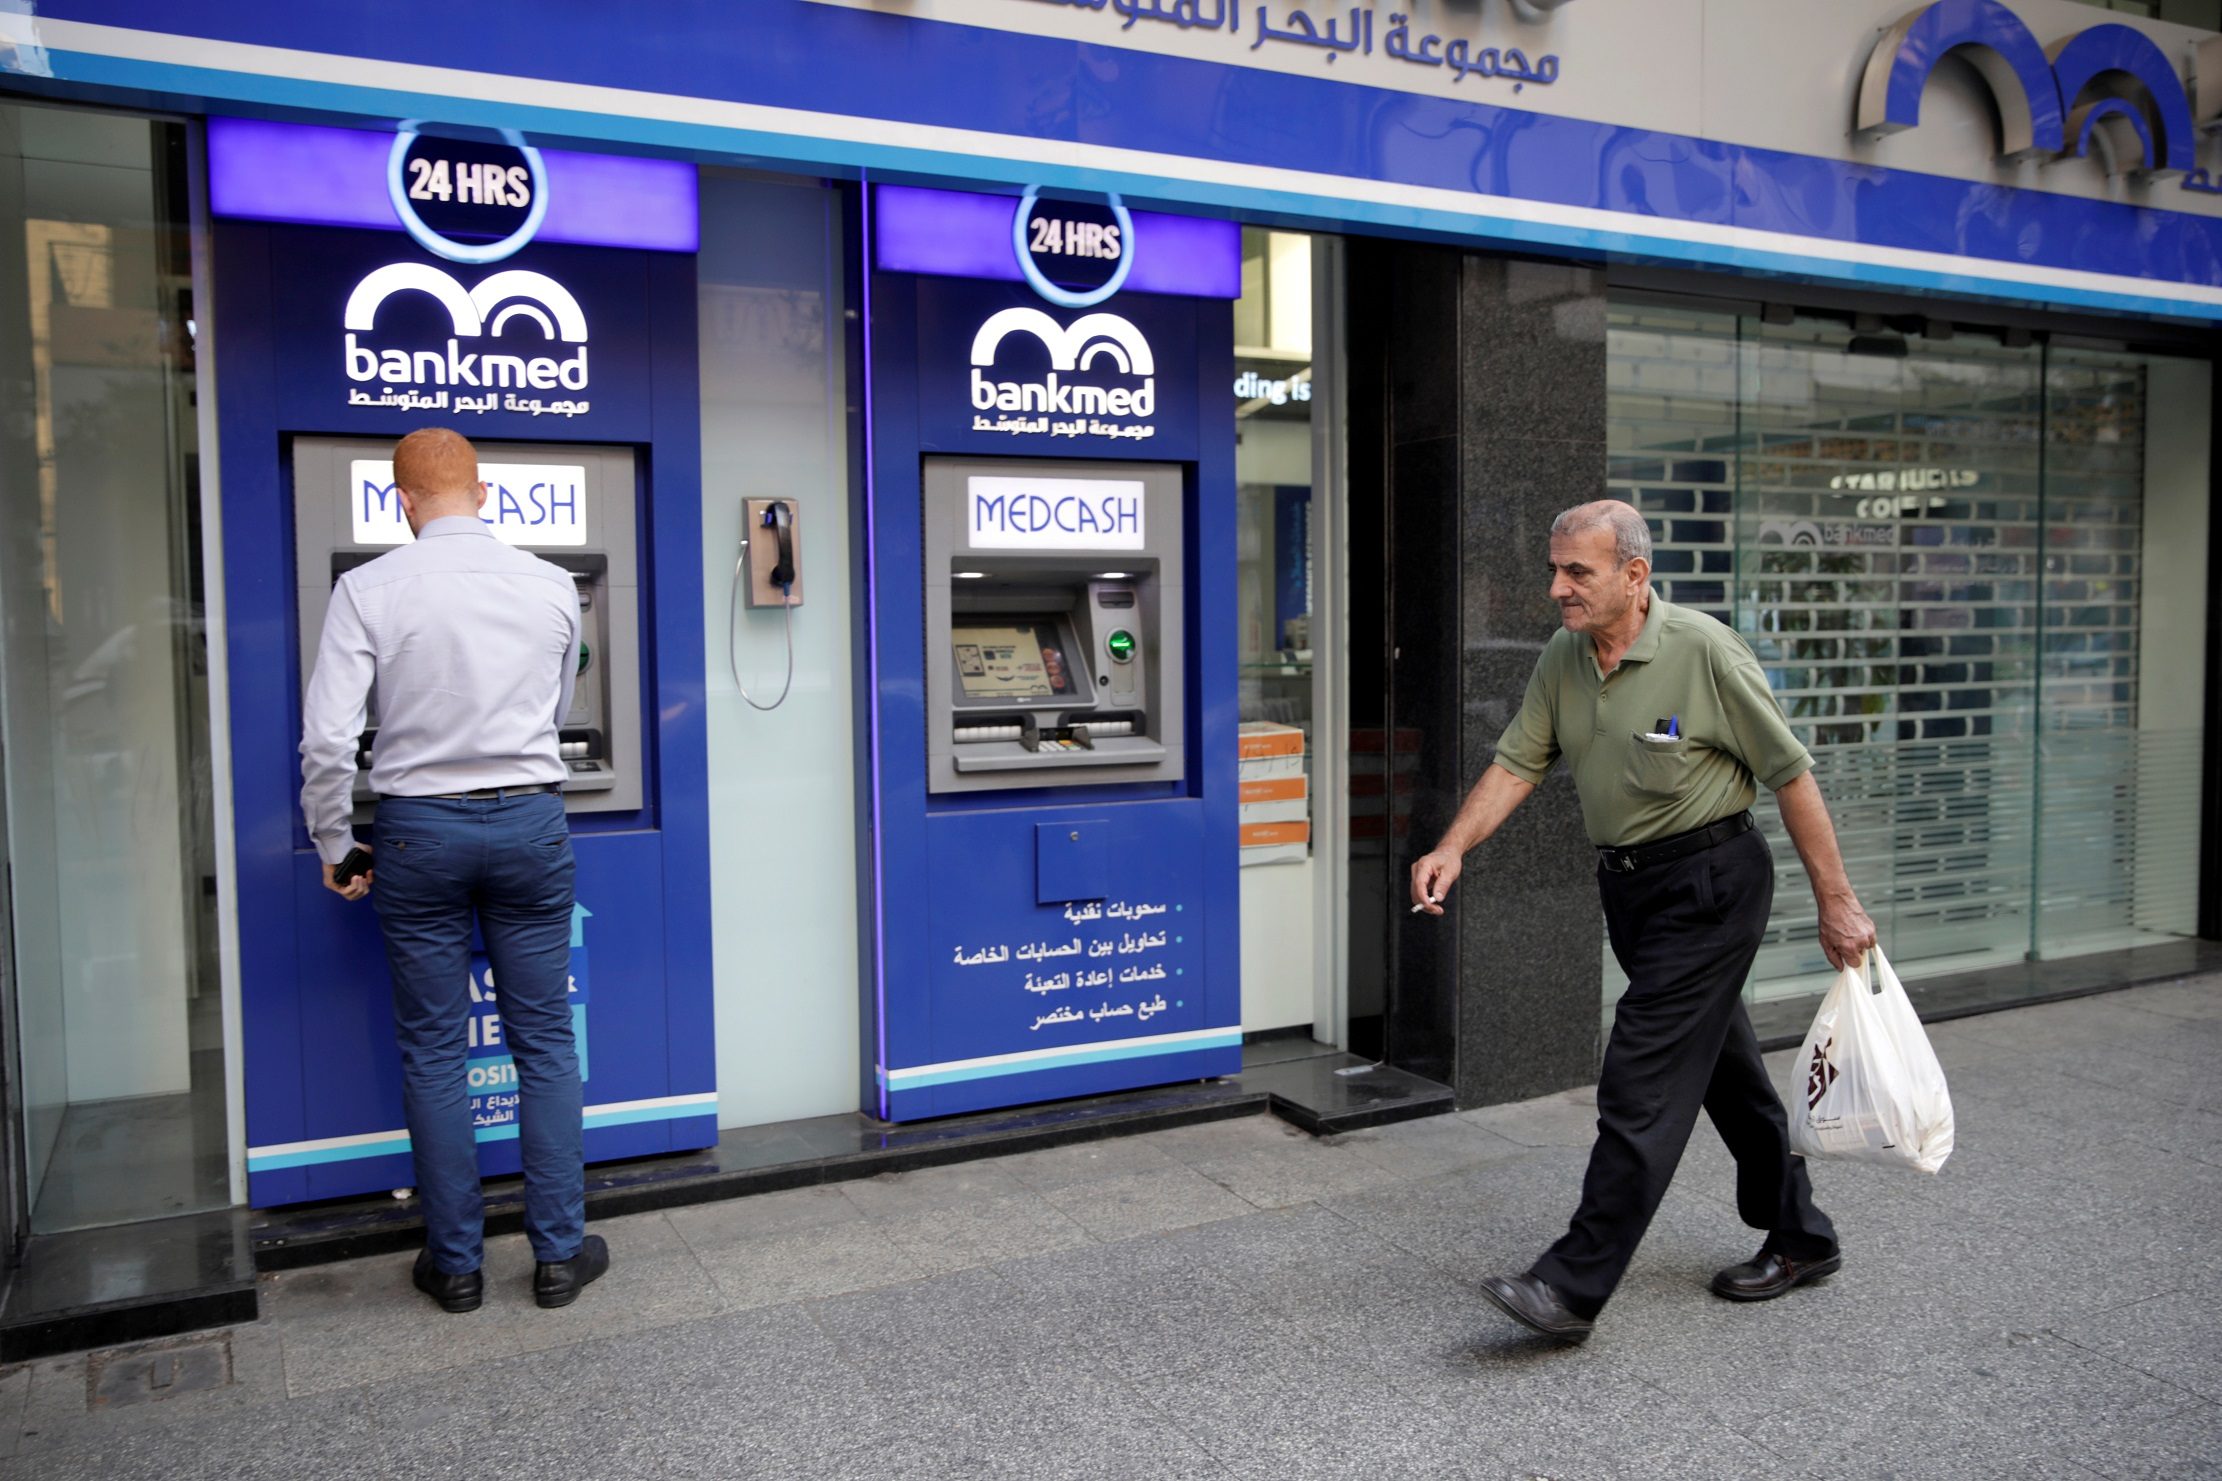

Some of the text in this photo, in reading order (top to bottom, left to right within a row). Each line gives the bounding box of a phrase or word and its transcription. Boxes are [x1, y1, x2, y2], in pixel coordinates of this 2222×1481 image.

[1250, 6, 1374, 64] البحر
[1384, 12, 1560, 94] مجموعة
[409, 157, 531, 208] 24 HRS
[1030, 216, 1122, 259] 24 HRS
[344, 333, 589, 391] bankmed
[347, 386, 590, 418] مجموعة البحر المتوسط
[971, 368, 1155, 417] bankmed
[972, 414, 1155, 441] مجموعة البحر المتوسط
[975, 493, 1139, 534] MEDCASH
[1063, 901, 1167, 925] سحوبات نقدية
[953, 930, 1167, 966] تحاويل بين الحسابات الخاصة
[1075, 967, 1114, 989] إعادة
[1119, 963, 1167, 983] خدمات
[1029, 994, 1168, 1031] طبع حساب مختصر
